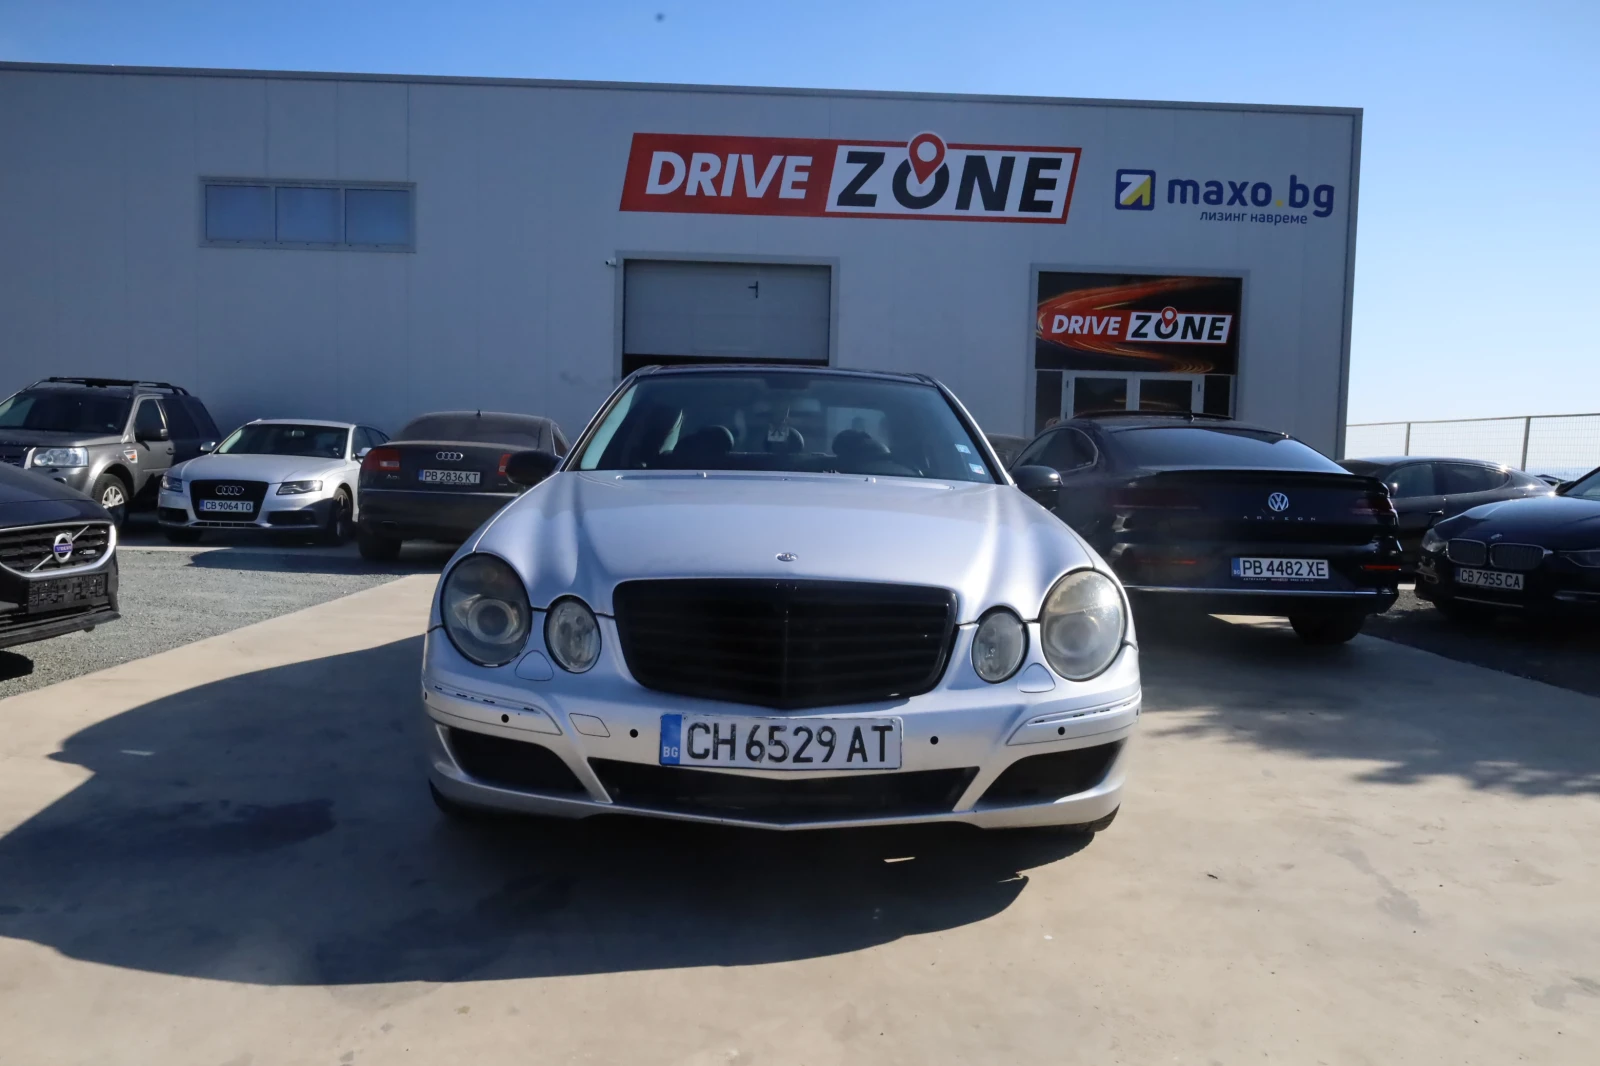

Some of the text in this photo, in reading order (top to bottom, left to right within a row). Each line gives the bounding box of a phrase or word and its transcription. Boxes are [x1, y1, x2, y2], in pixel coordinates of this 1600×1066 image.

[645, 150, 1063, 213] DRIVE ZONE
[1167, 174, 1335, 218] maxo.bg
[1200, 211, 1308, 226] лизинг навреме
[1051, 314, 1226, 341] DRIVE ZONE
[424, 470, 479, 483] PB 2836 KT
[205, 501, 217, 510] CB
[218, 501, 239, 511] 9064
[1242, 560, 1326, 577] PB 4482 XE
[1461, 570, 1520, 588] CB 7955 CA
[687, 722, 894, 763] CH 6529 AT
[663, 746, 679, 758] BG
